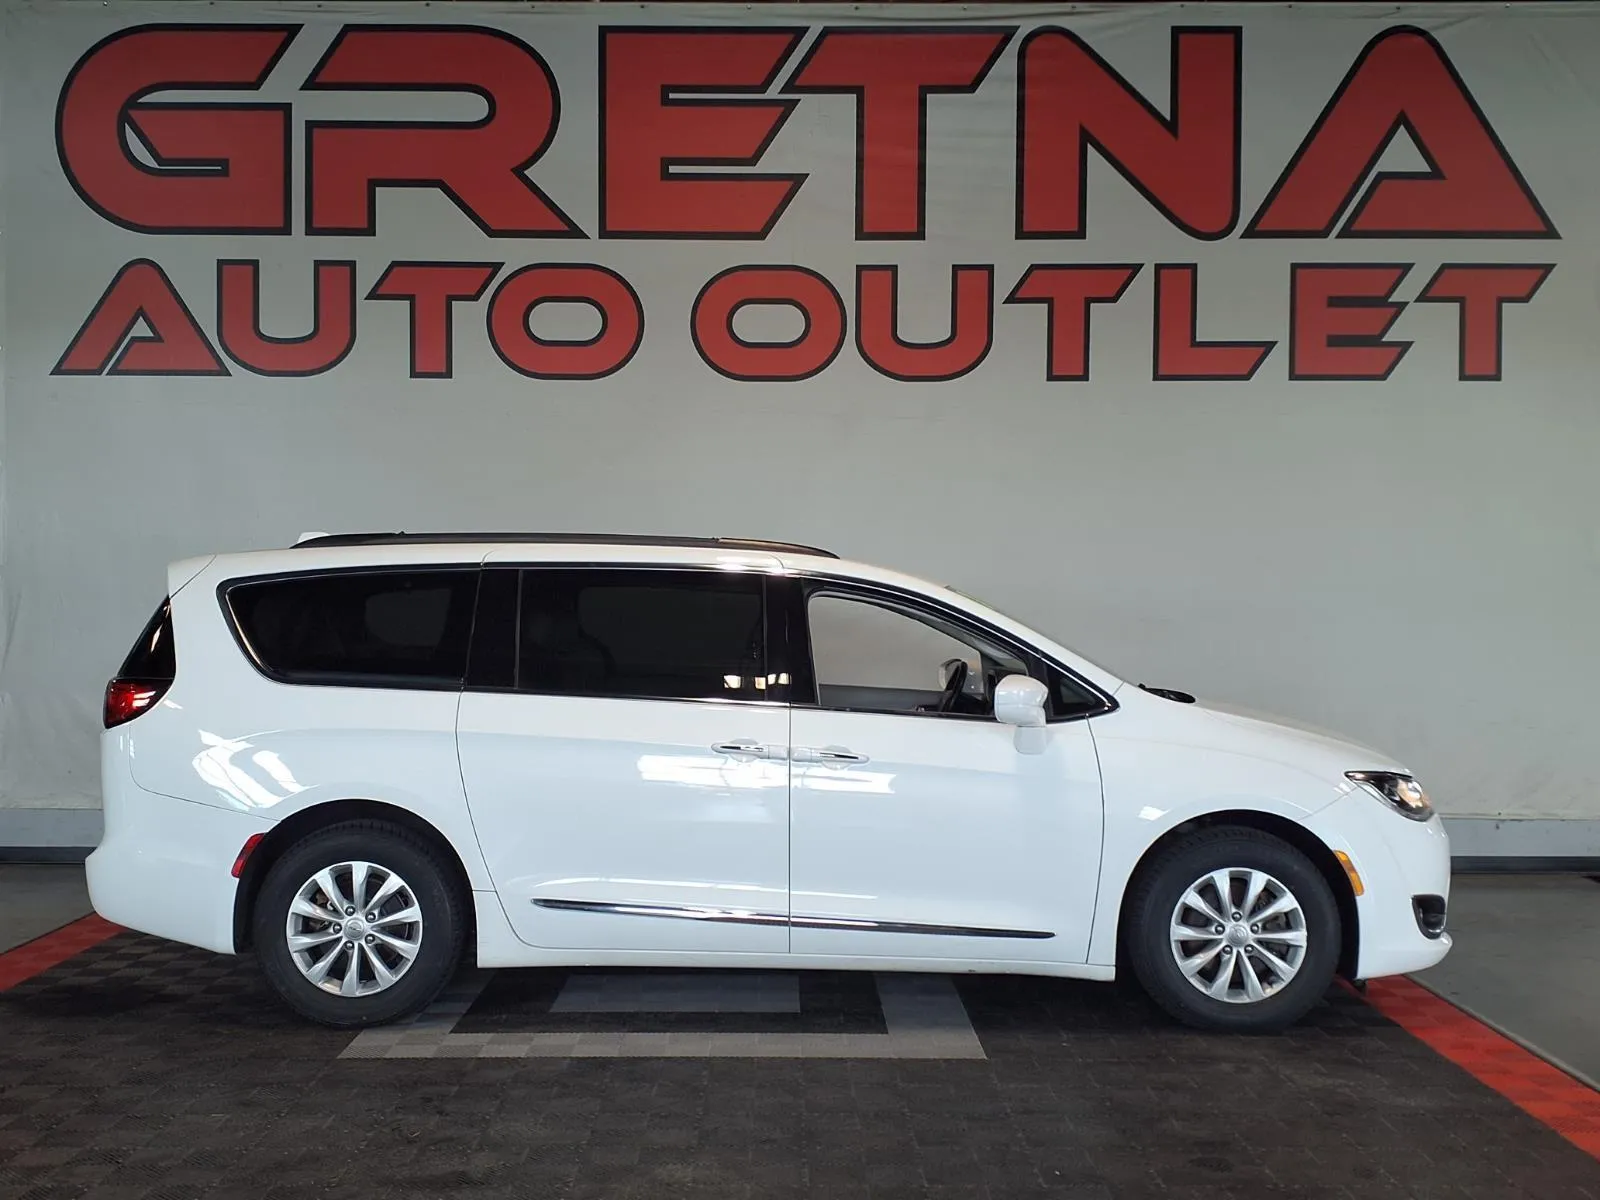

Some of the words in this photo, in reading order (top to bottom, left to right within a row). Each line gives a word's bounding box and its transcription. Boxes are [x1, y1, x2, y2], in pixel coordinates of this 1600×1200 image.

[55, 23, 1561, 241] GRETNA
[50, 258, 644, 380] AUTO
[690, 262, 1556, 382] OUTLET
